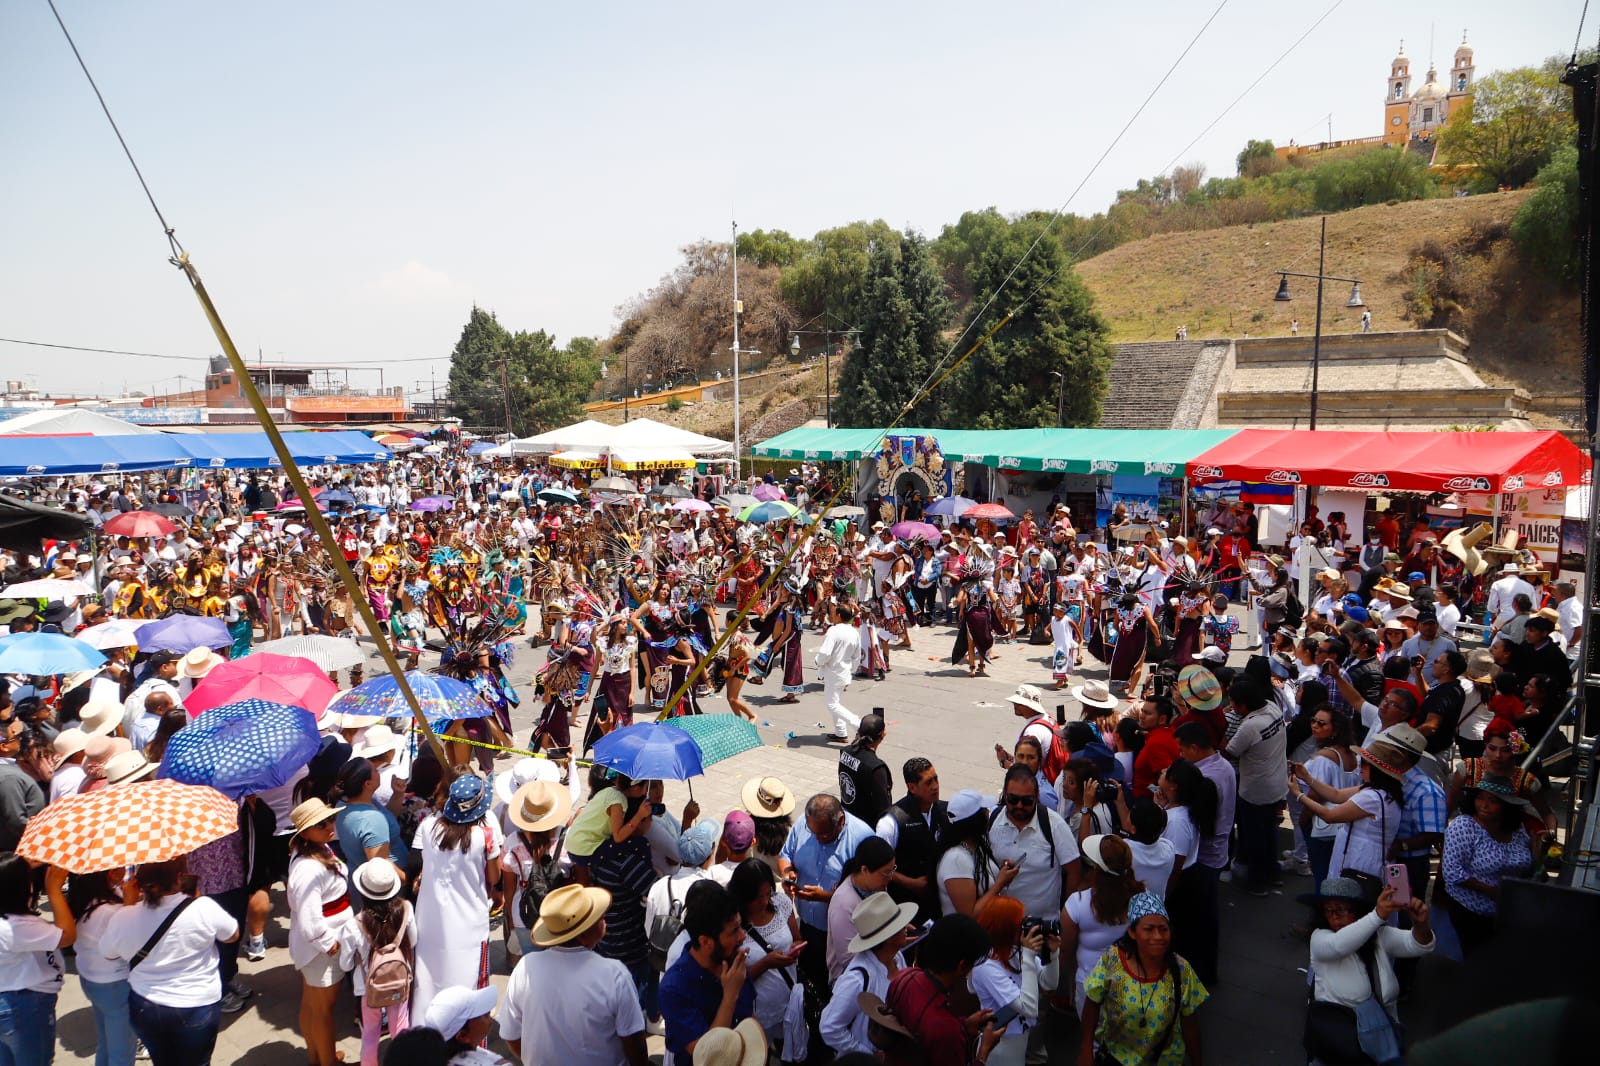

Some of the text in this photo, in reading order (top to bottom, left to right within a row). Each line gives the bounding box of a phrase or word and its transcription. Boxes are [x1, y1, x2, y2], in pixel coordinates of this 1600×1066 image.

[636, 460, 686, 470] Helados
[1089, 459, 1119, 475] BOING!
[1144, 461, 1177, 476] BOING!
